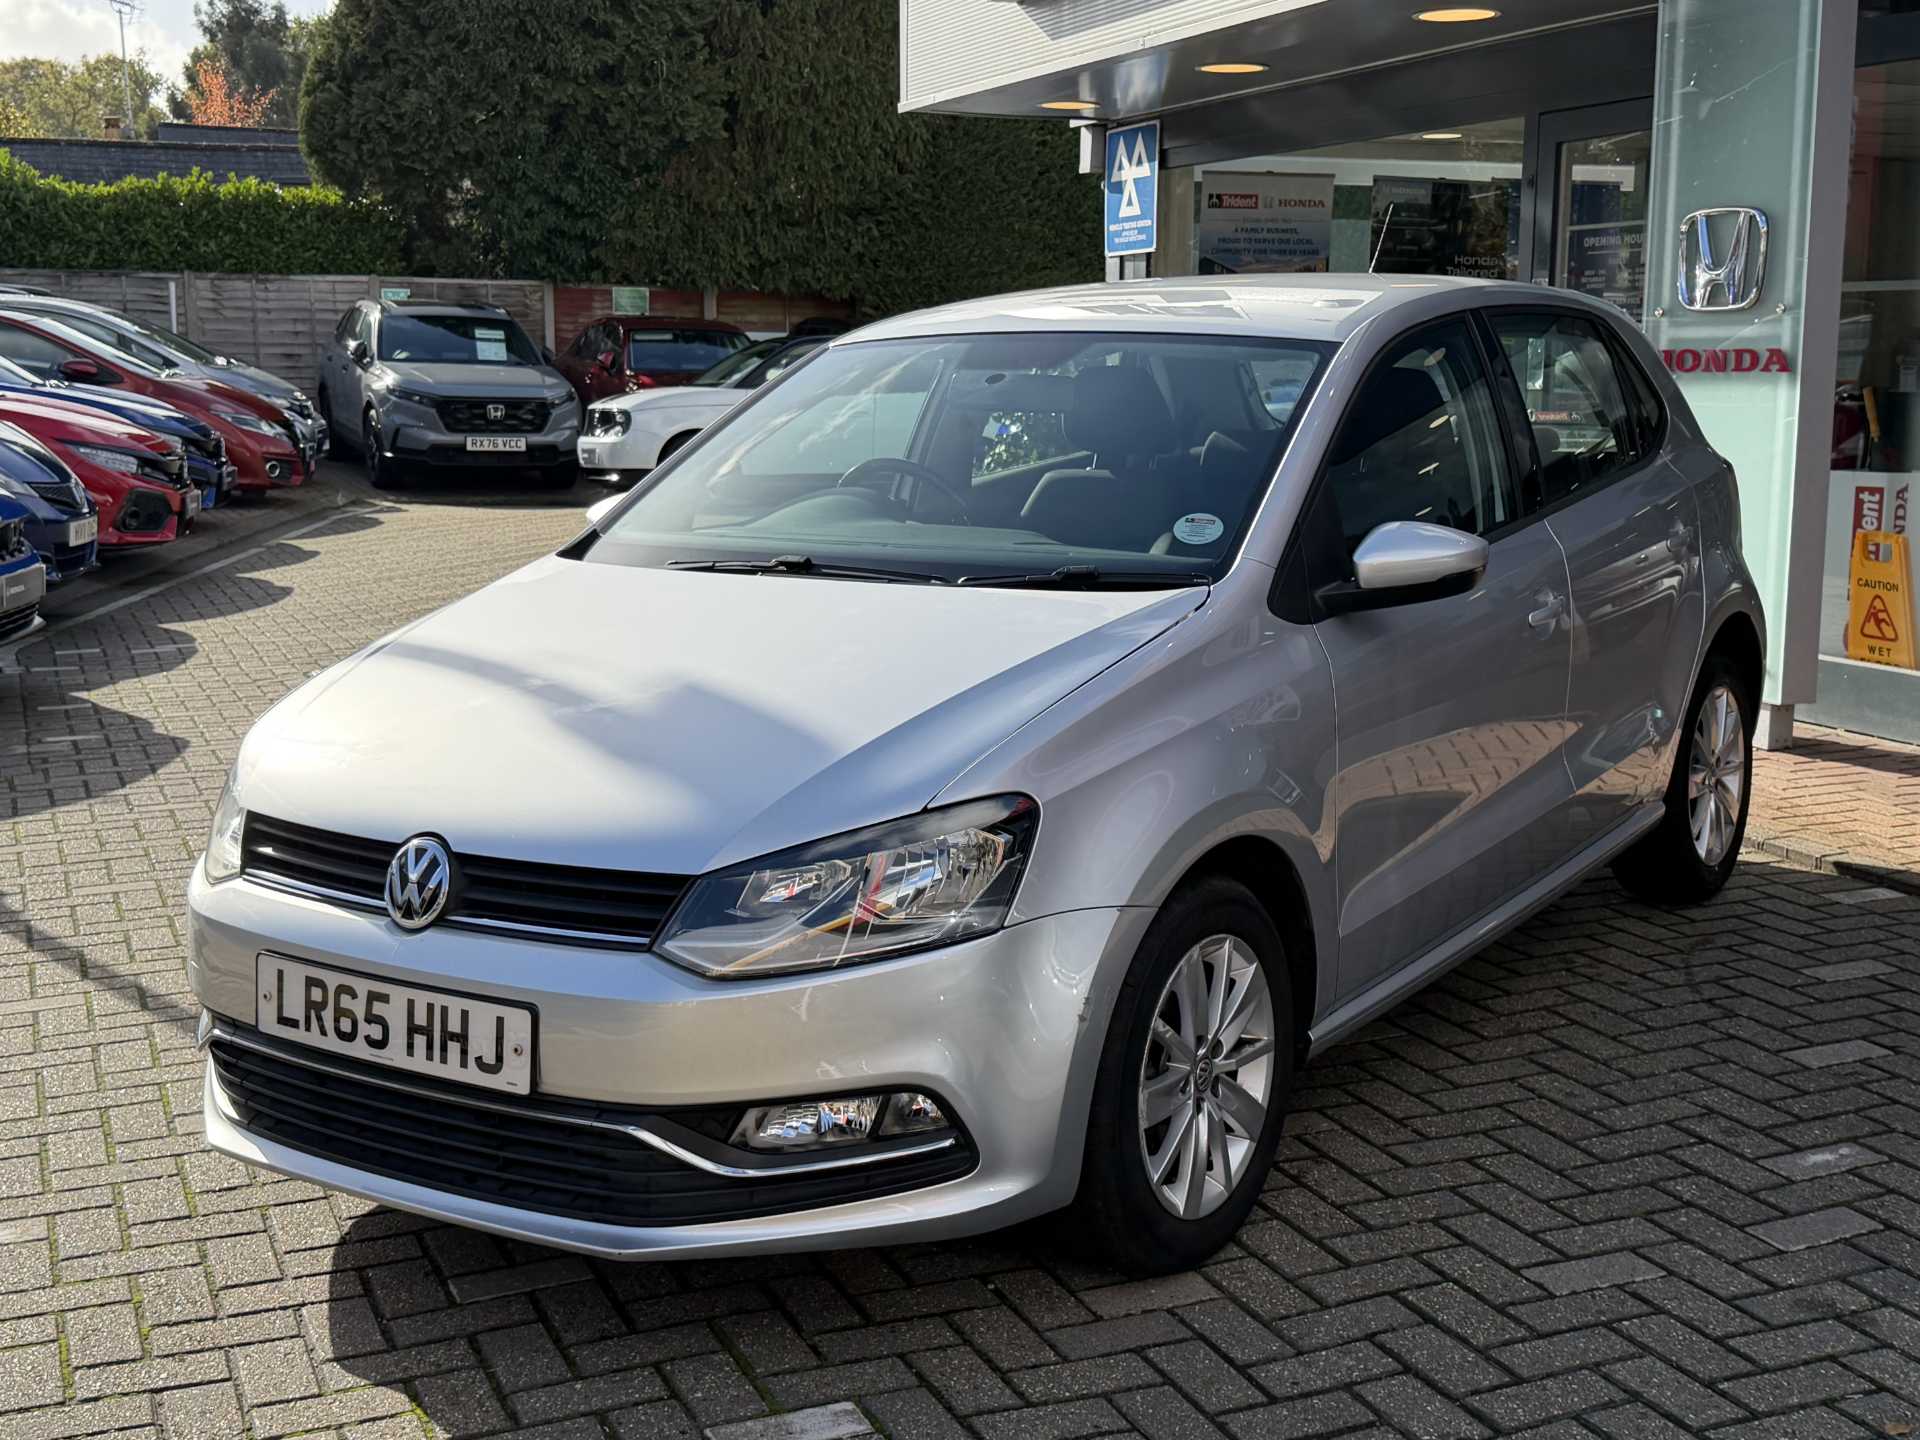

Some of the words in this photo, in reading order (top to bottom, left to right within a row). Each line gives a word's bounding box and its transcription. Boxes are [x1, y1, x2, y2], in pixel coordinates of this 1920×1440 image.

[1221, 195, 1257, 207] Trident
[1278, 199, 1326, 208] HONDA
[1584, 236, 1621, 248] OPENING
[1455, 254, 1498, 265] Honda
[1446, 266, 1498, 278] Tailored
[502, 438, 522, 449] VCC
[1857, 577, 1899, 592] CAUTION
[1868, 644, 1892, 657] WET
[277, 968, 390, 1050] LR65
[406, 998, 504, 1075] HHJ
